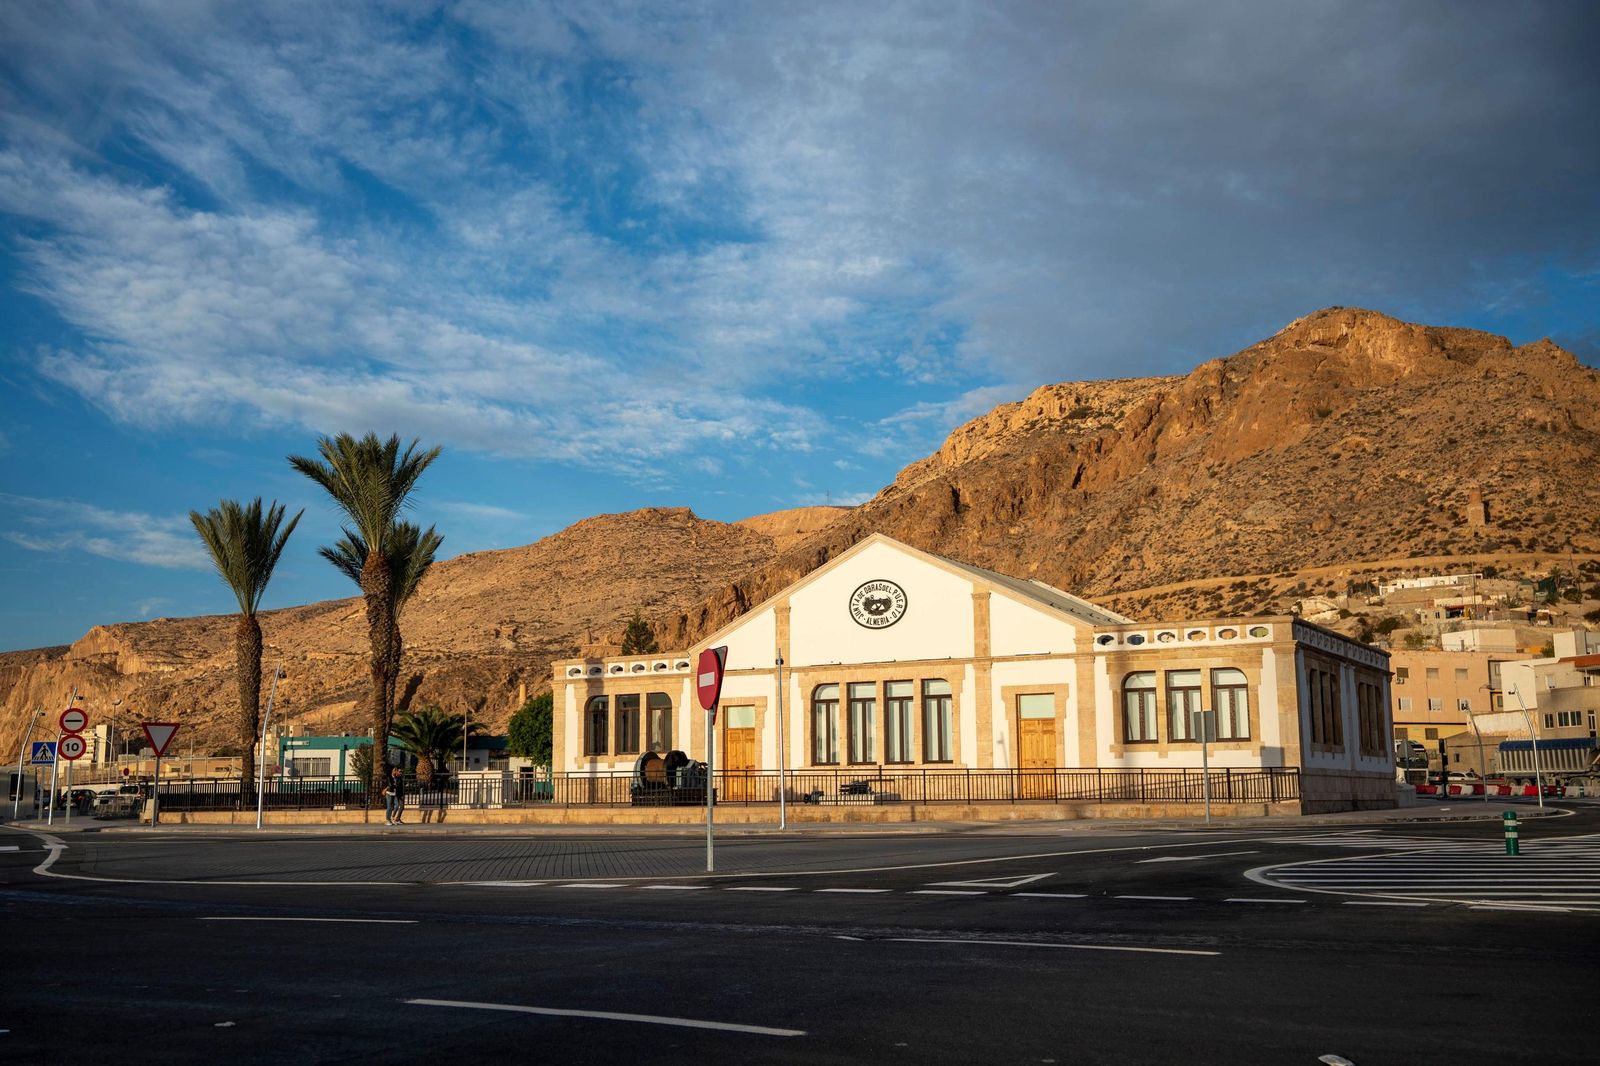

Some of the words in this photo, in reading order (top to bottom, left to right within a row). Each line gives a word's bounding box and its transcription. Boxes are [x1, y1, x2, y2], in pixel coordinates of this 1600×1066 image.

[857, 591, 865, 599] DE
[852, 598, 864, 619] JUNTA
[892, 589, 903, 619] PUERTO
[65, 743, 79, 752] 10
